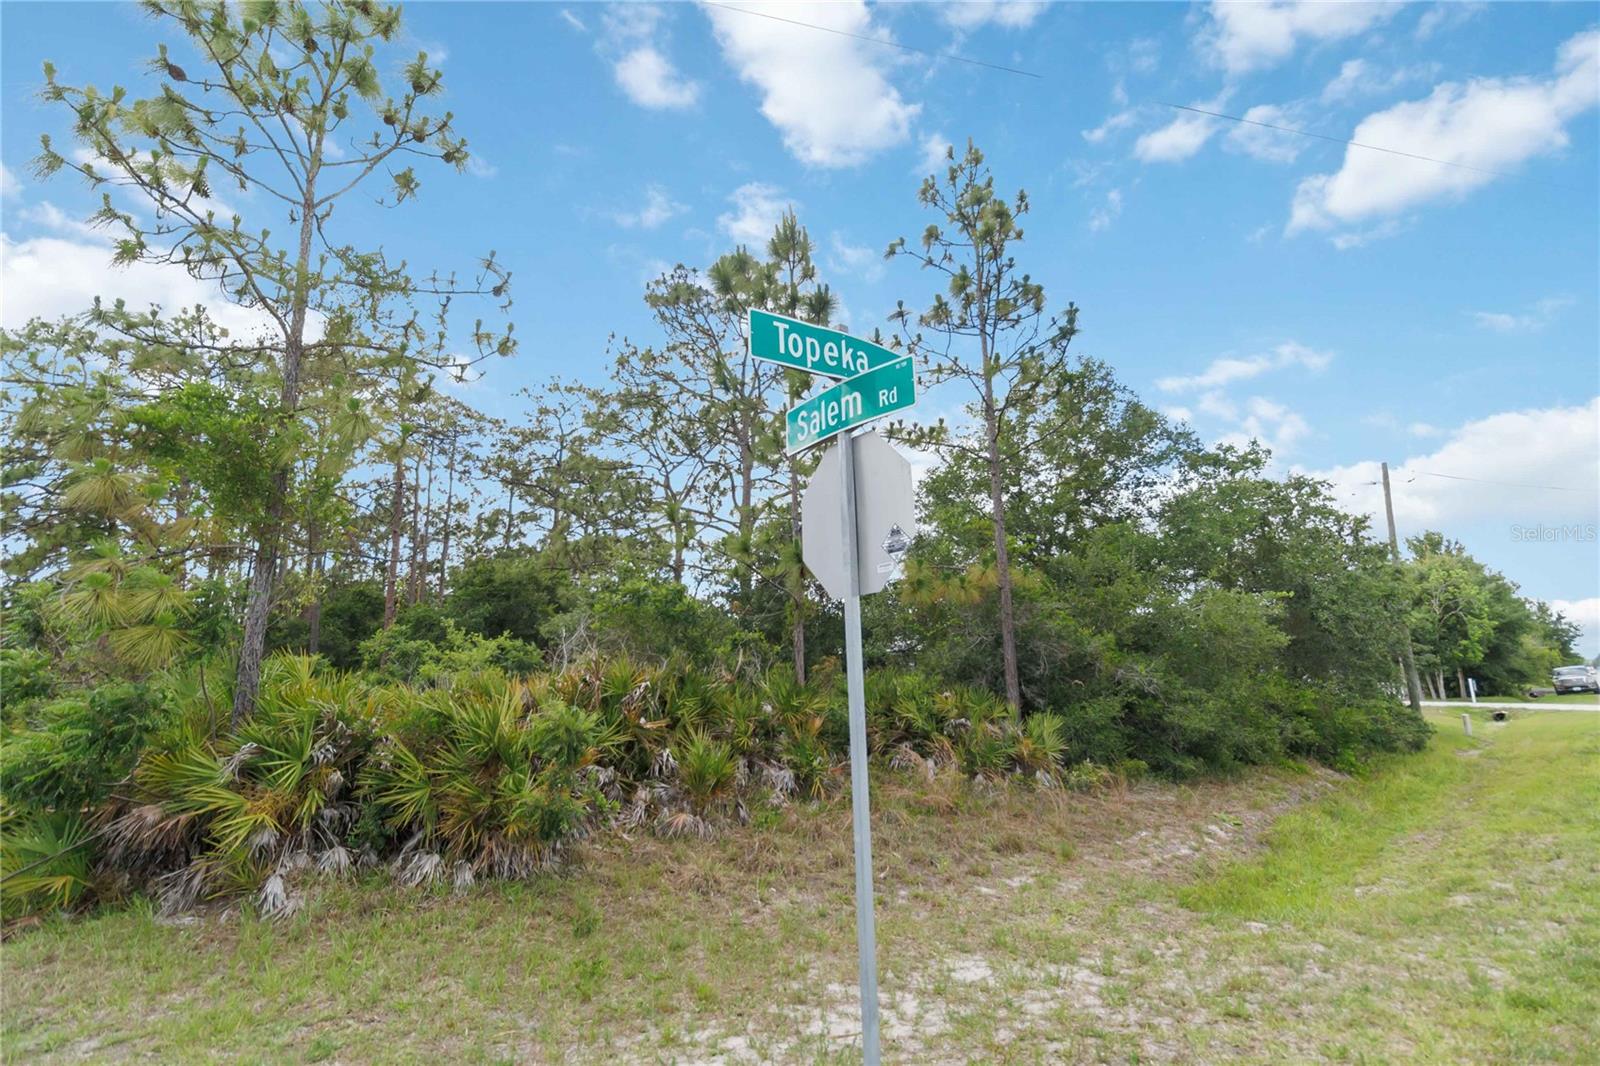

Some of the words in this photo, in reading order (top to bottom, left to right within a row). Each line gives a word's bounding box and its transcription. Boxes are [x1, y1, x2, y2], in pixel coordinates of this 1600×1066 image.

[773, 321, 868, 374] Topeka
[797, 391, 862, 441] Salem
[879, 386, 897, 407] Rd
